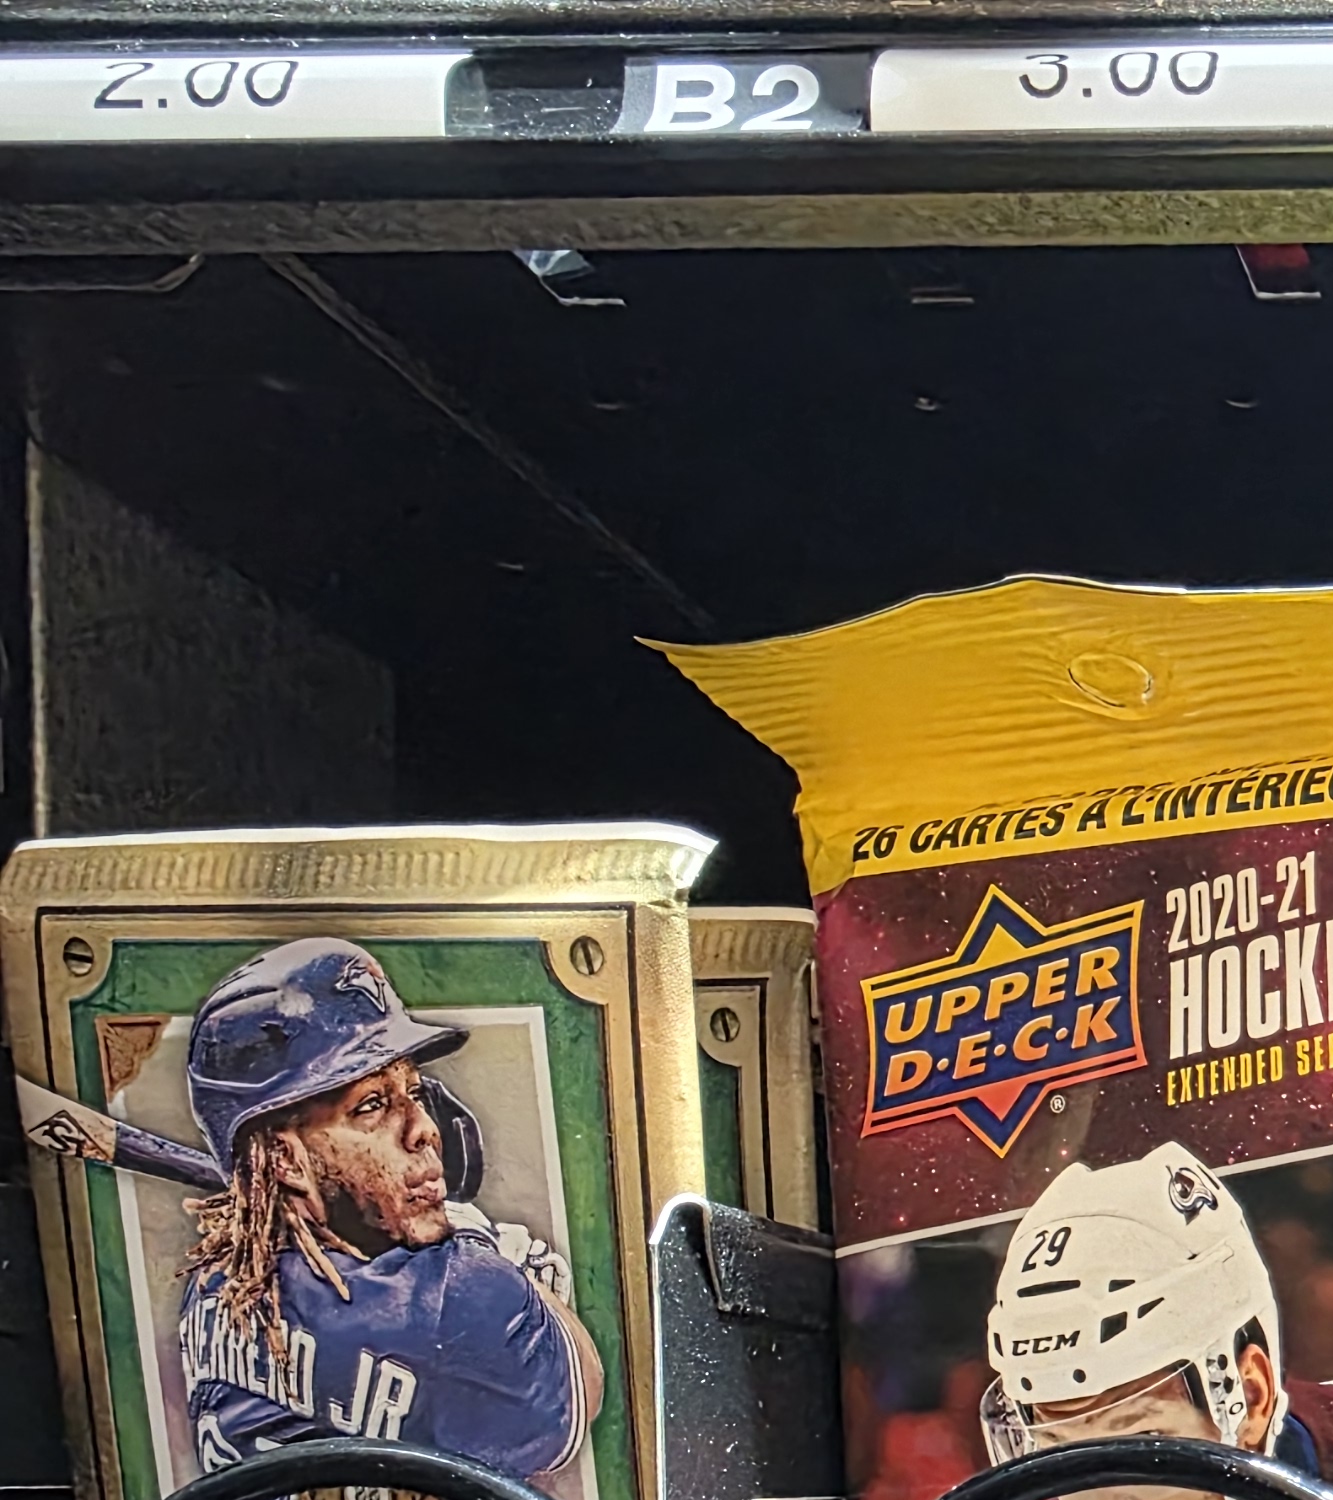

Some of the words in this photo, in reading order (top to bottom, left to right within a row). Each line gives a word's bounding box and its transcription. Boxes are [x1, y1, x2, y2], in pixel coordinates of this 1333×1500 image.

[94, 60, 300, 109] 2.00
[644, 63, 821, 132] B2
[1019, 49, 1219, 99] 3.00
[853, 825, 903, 862] 26
[910, 800, 1075, 853] CARTES
[1166, 853, 1317, 954] 2020-21
[883, 945, 1122, 1044] UPPER
[1167, 1047, 1283, 1106] EXTENDED
[1021, 1226, 1072, 1273] 29
[1012, 1329, 1081, 1356] CCM
[329, 1348, 417, 1442] JR
